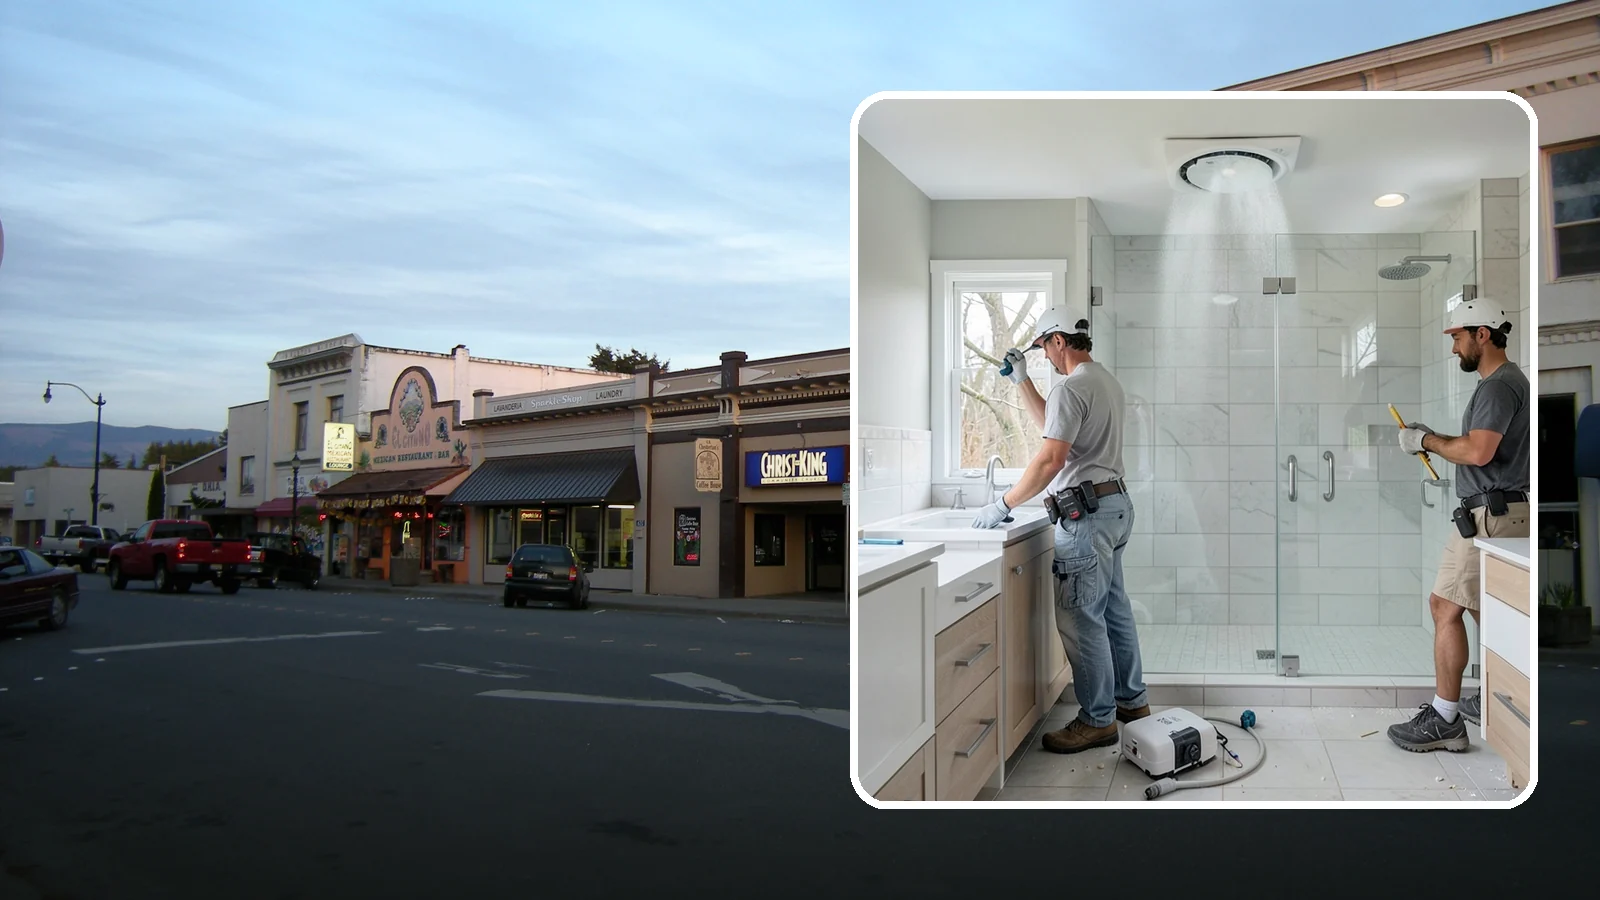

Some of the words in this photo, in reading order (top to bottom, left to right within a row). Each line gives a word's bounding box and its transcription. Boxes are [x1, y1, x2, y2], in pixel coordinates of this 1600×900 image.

[531, 398, 560, 409] Sparkle
[561, 394, 582, 405] Shop
[595, 389, 623, 400] LAUNDRY
[493, 402, 522, 413] LAVANDERIA
[374, 454, 396, 465] MEXICAN
[397, 451, 433, 463] RESTAURANT
[438, 450, 450, 459] BAR
[761, 452, 797, 478] CHRIST
[799, 450, 827, 476] KING
